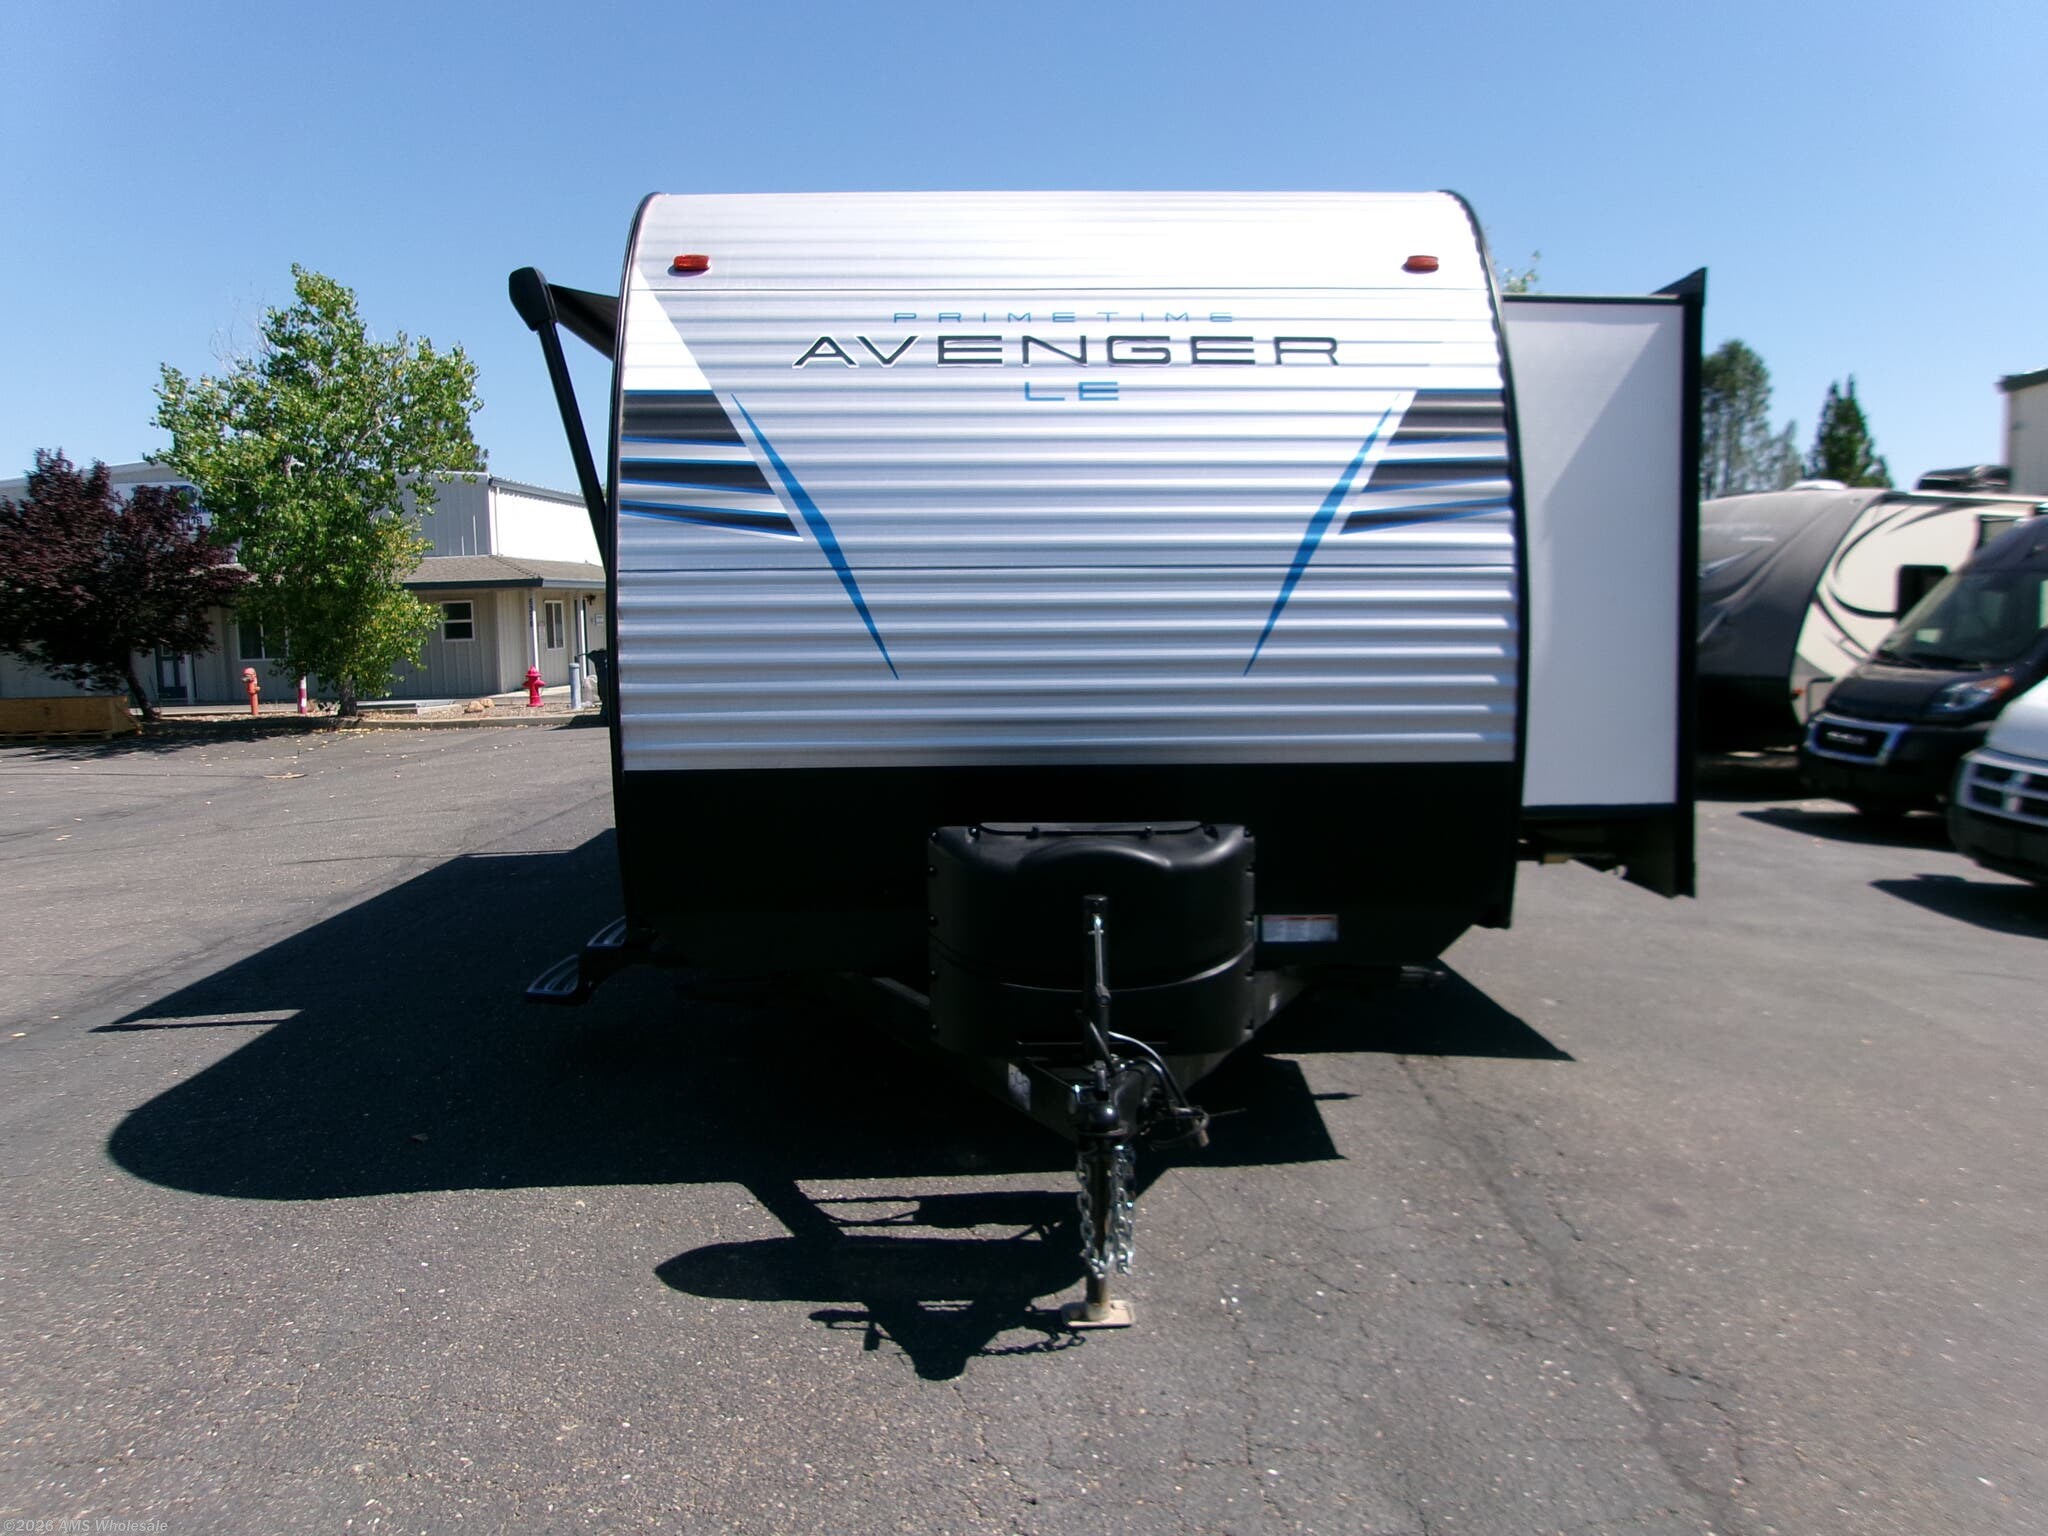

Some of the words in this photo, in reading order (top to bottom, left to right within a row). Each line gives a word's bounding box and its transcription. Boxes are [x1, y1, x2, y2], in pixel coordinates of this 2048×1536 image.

[893, 311, 1234, 323] PRIMETIME
[792, 335, 1340, 368] AVENGER
[1024, 381, 1119, 401] LE
